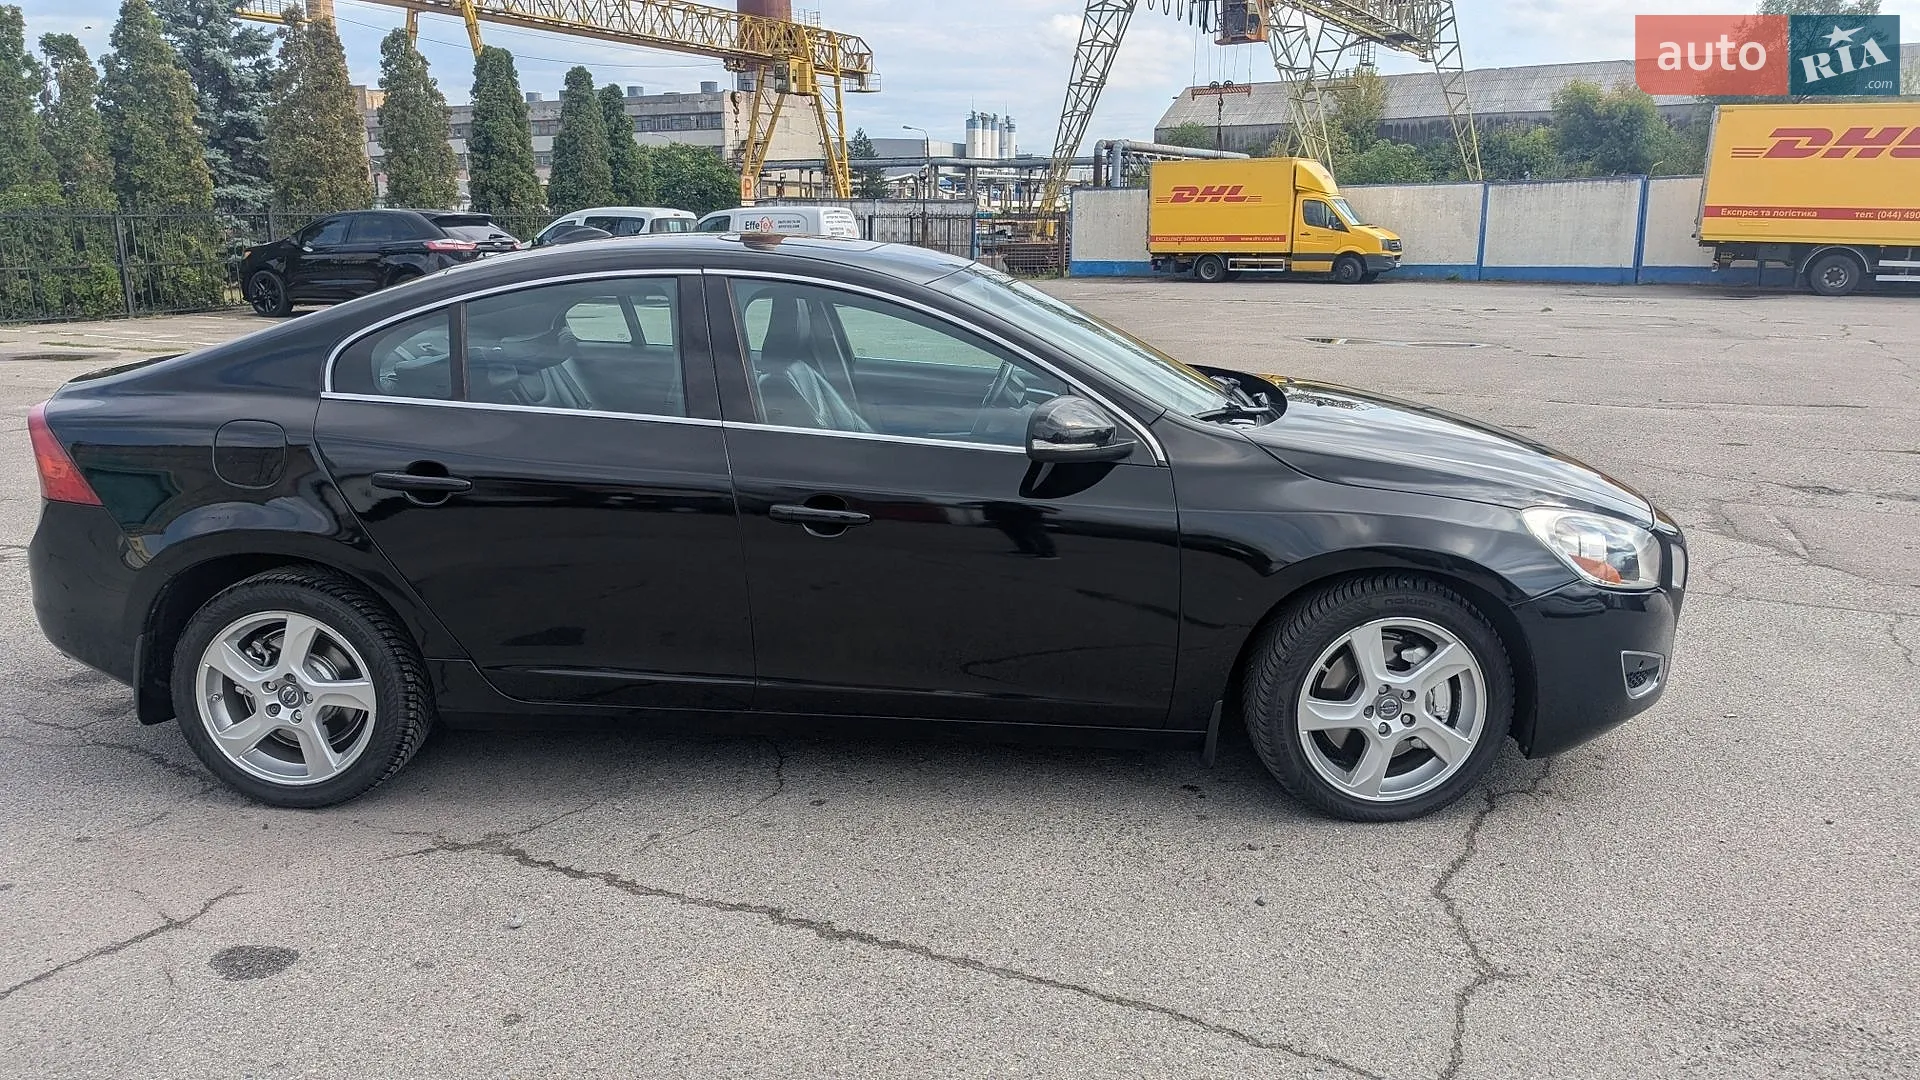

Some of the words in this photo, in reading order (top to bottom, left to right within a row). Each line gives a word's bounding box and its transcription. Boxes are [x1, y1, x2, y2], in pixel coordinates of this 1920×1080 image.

[1170, 185, 1247, 203] DHL
[1721, 207, 1759, 217] Експрес
[1772, 209, 1818, 218] логістика
[1877, 210, 1902, 220] (044)
